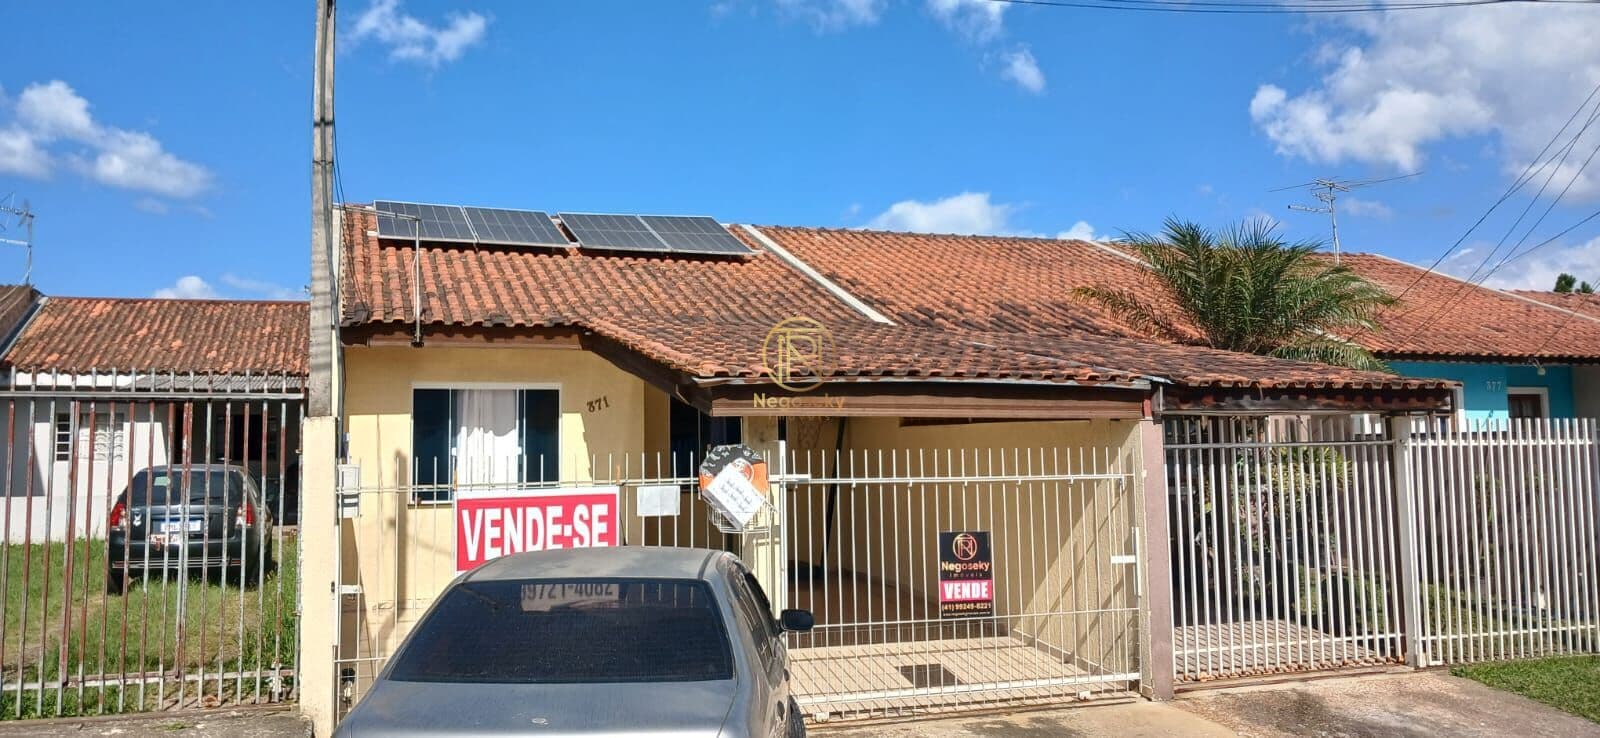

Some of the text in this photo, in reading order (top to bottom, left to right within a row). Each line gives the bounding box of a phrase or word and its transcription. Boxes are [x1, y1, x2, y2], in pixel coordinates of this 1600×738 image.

[586, 395, 609, 413] 371
[461, 503, 609, 561] VENDE-SE
[941, 561, 989, 572] Negoseky
[943, 582, 988, 599] VENDE
